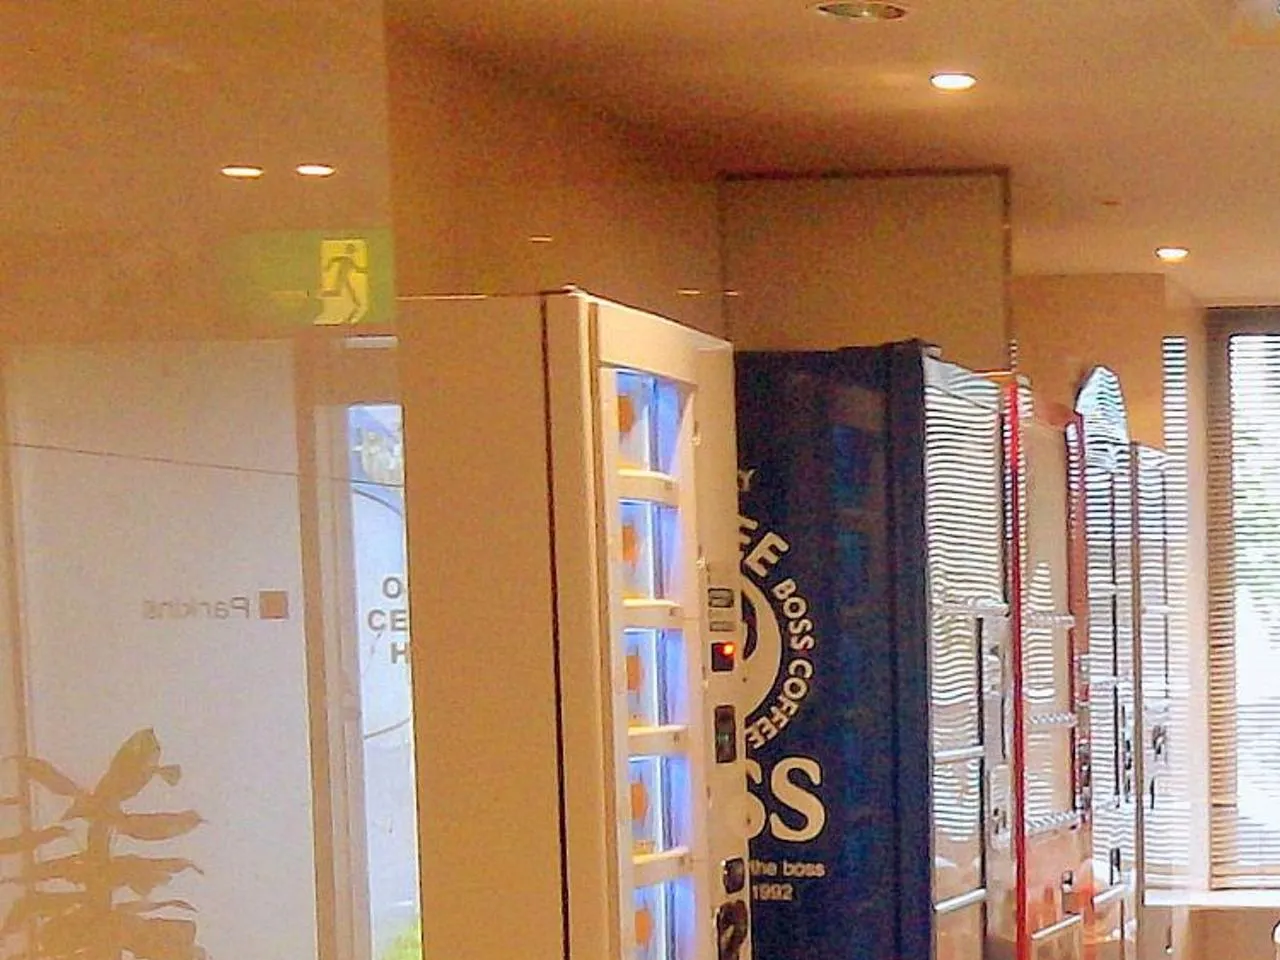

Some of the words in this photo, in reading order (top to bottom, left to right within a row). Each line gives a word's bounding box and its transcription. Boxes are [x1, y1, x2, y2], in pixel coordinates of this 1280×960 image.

[773, 578, 815, 651] BOSS
[745, 658, 814, 749] COFFEE
[783, 859, 826, 877] boss
[752, 882, 793, 901] 1992
